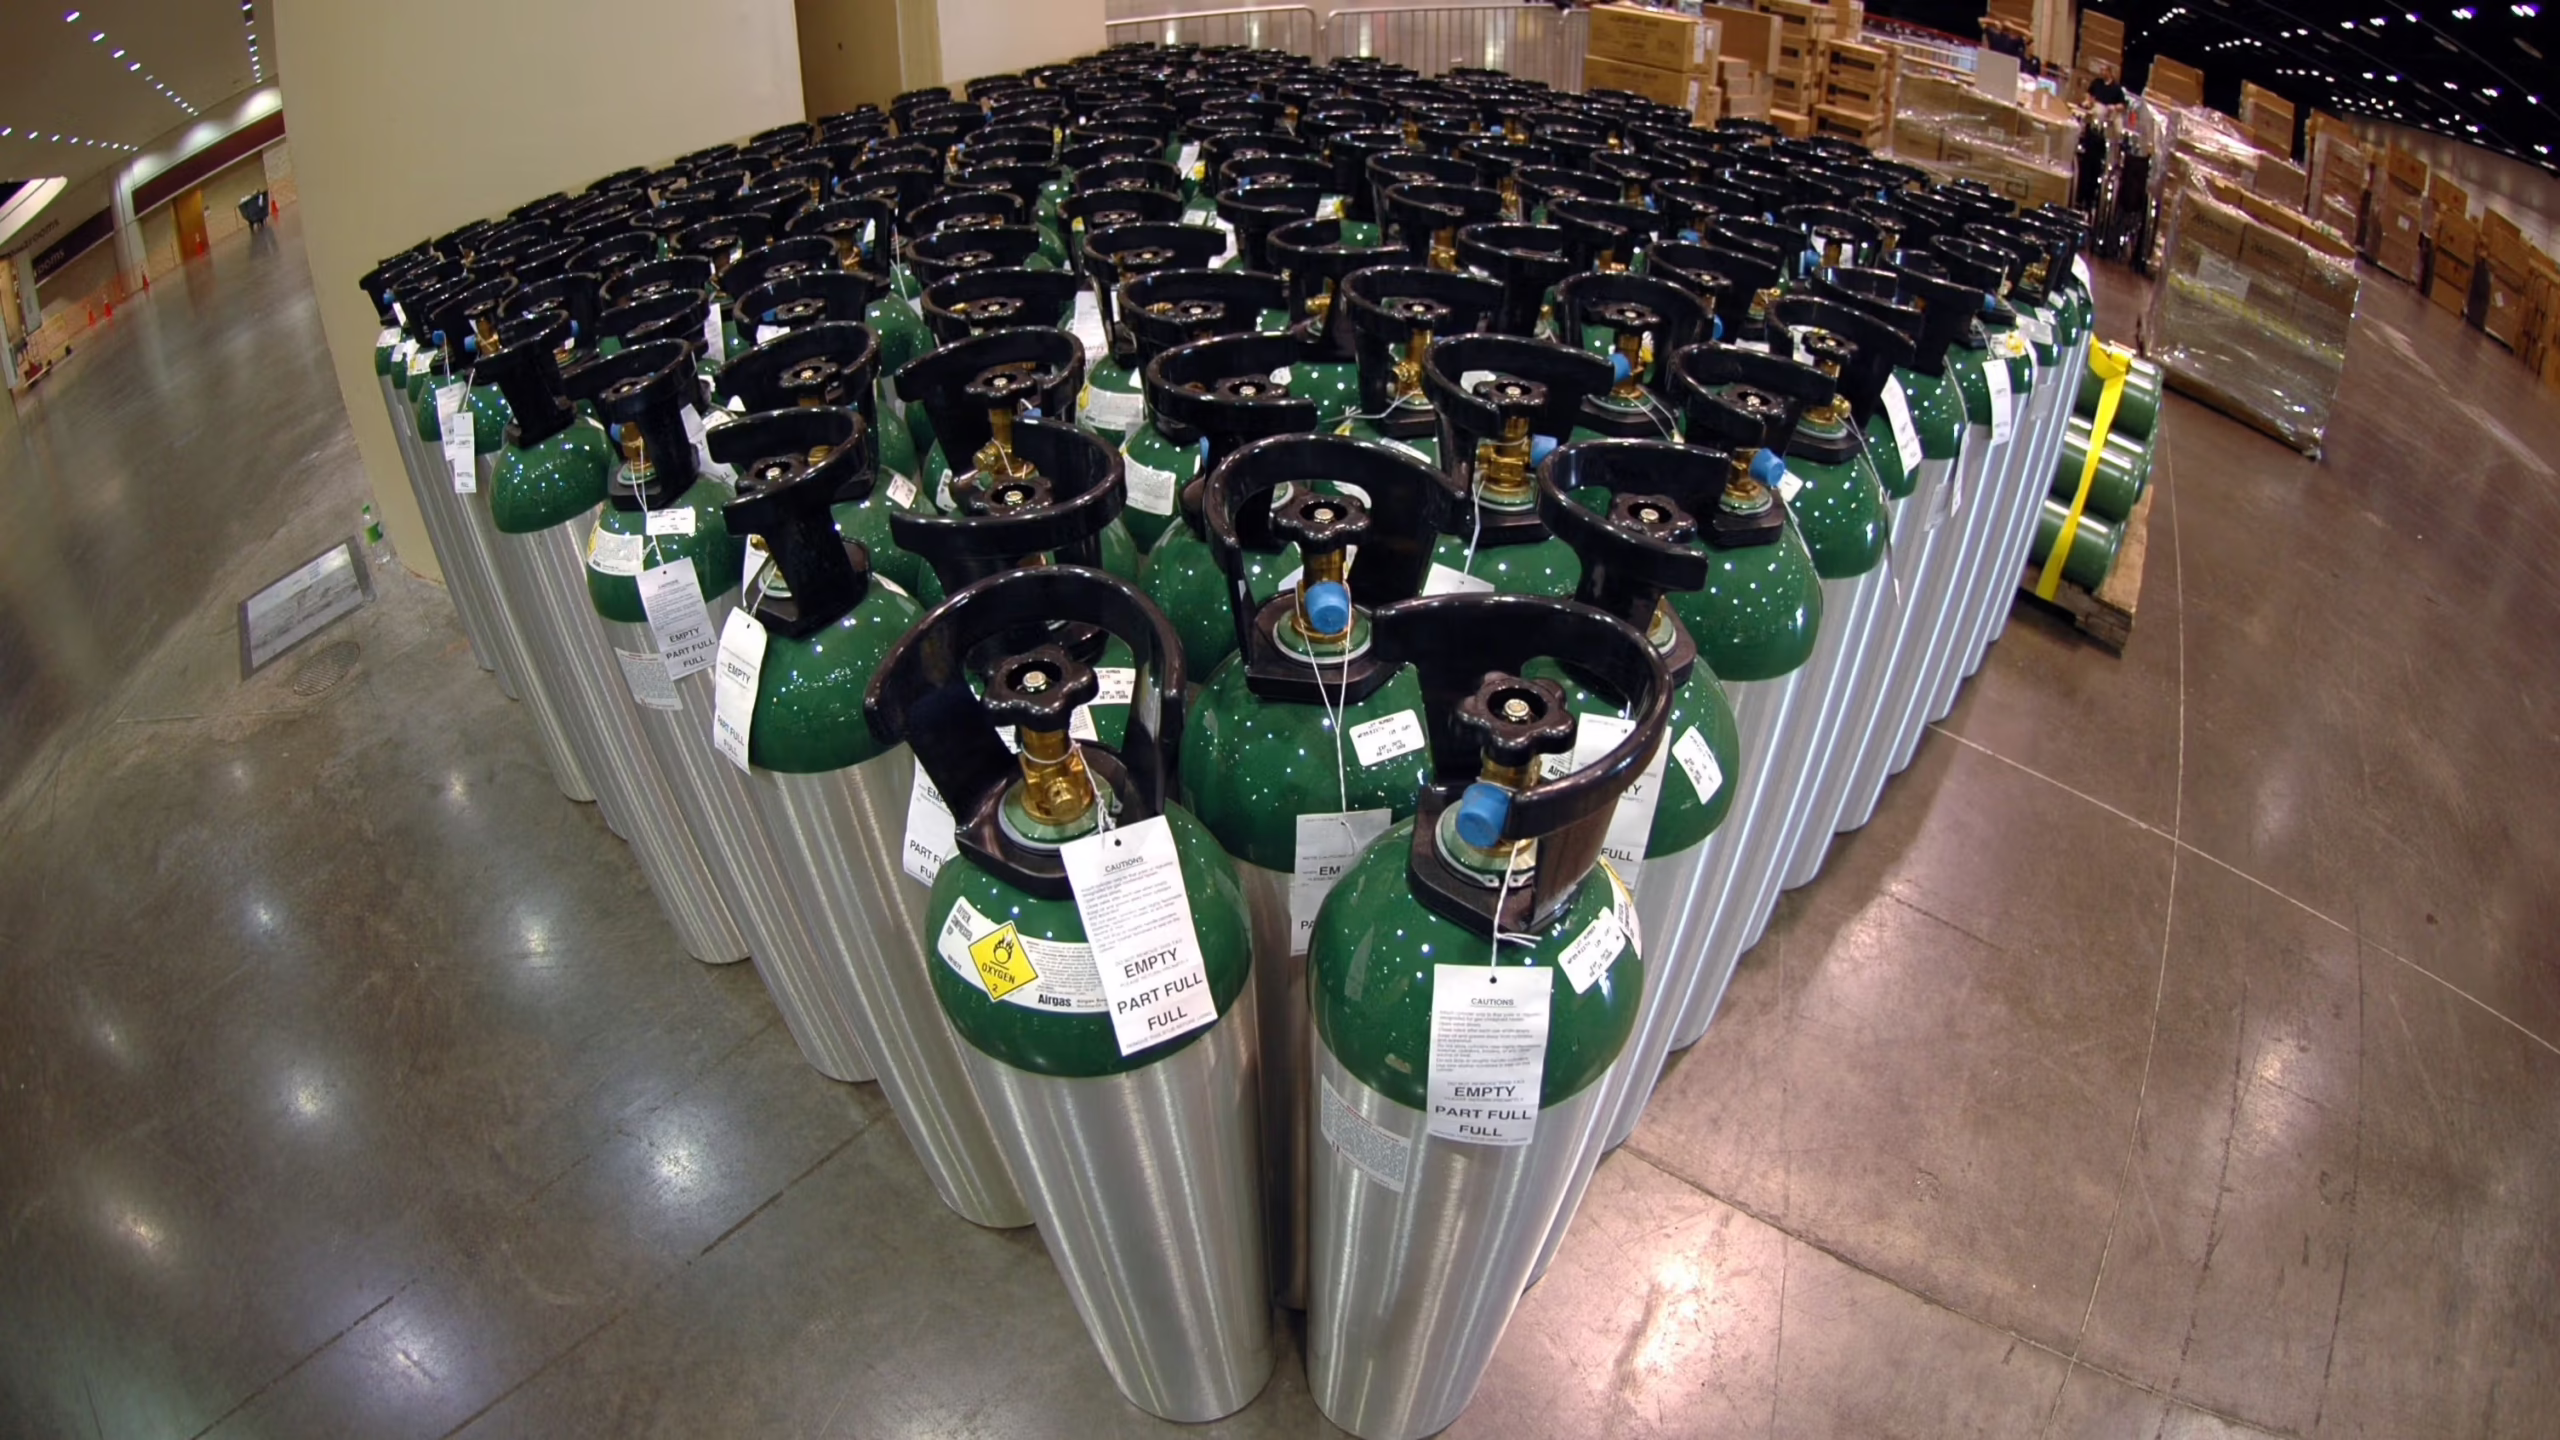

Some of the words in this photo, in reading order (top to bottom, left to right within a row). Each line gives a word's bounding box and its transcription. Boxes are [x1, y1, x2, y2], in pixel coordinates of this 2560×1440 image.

[669, 627, 700, 643] EMPTY
[666, 647, 690, 660] PART
[693, 638, 715, 652] FULL
[683, 655, 706, 668] FULL
[727, 662, 751, 685] EMPTY
[910, 839, 932, 861] PART
[1600, 847, 1633, 862] FULL
[1105, 856, 1144, 873] CAUTIONS
[1124, 947, 1177, 979] EMPTY
[981, 962, 1016, 984] OXYGEN
[991, 983, 998, 993] 2
[1117, 987, 1160, 1015] PART
[1164, 972, 1203, 997] FULL
[1038, 993, 1072, 1008] Airgas
[1471, 998, 1514, 1006] CAUTIONS
[1147, 1006, 1188, 1031] FULL
[1454, 1086, 1516, 1097] EMPTY
[1435, 1105, 1483, 1119] PART
[1487, 1109, 1532, 1120] FULL
[1459, 1124, 1503, 1137] FULL
